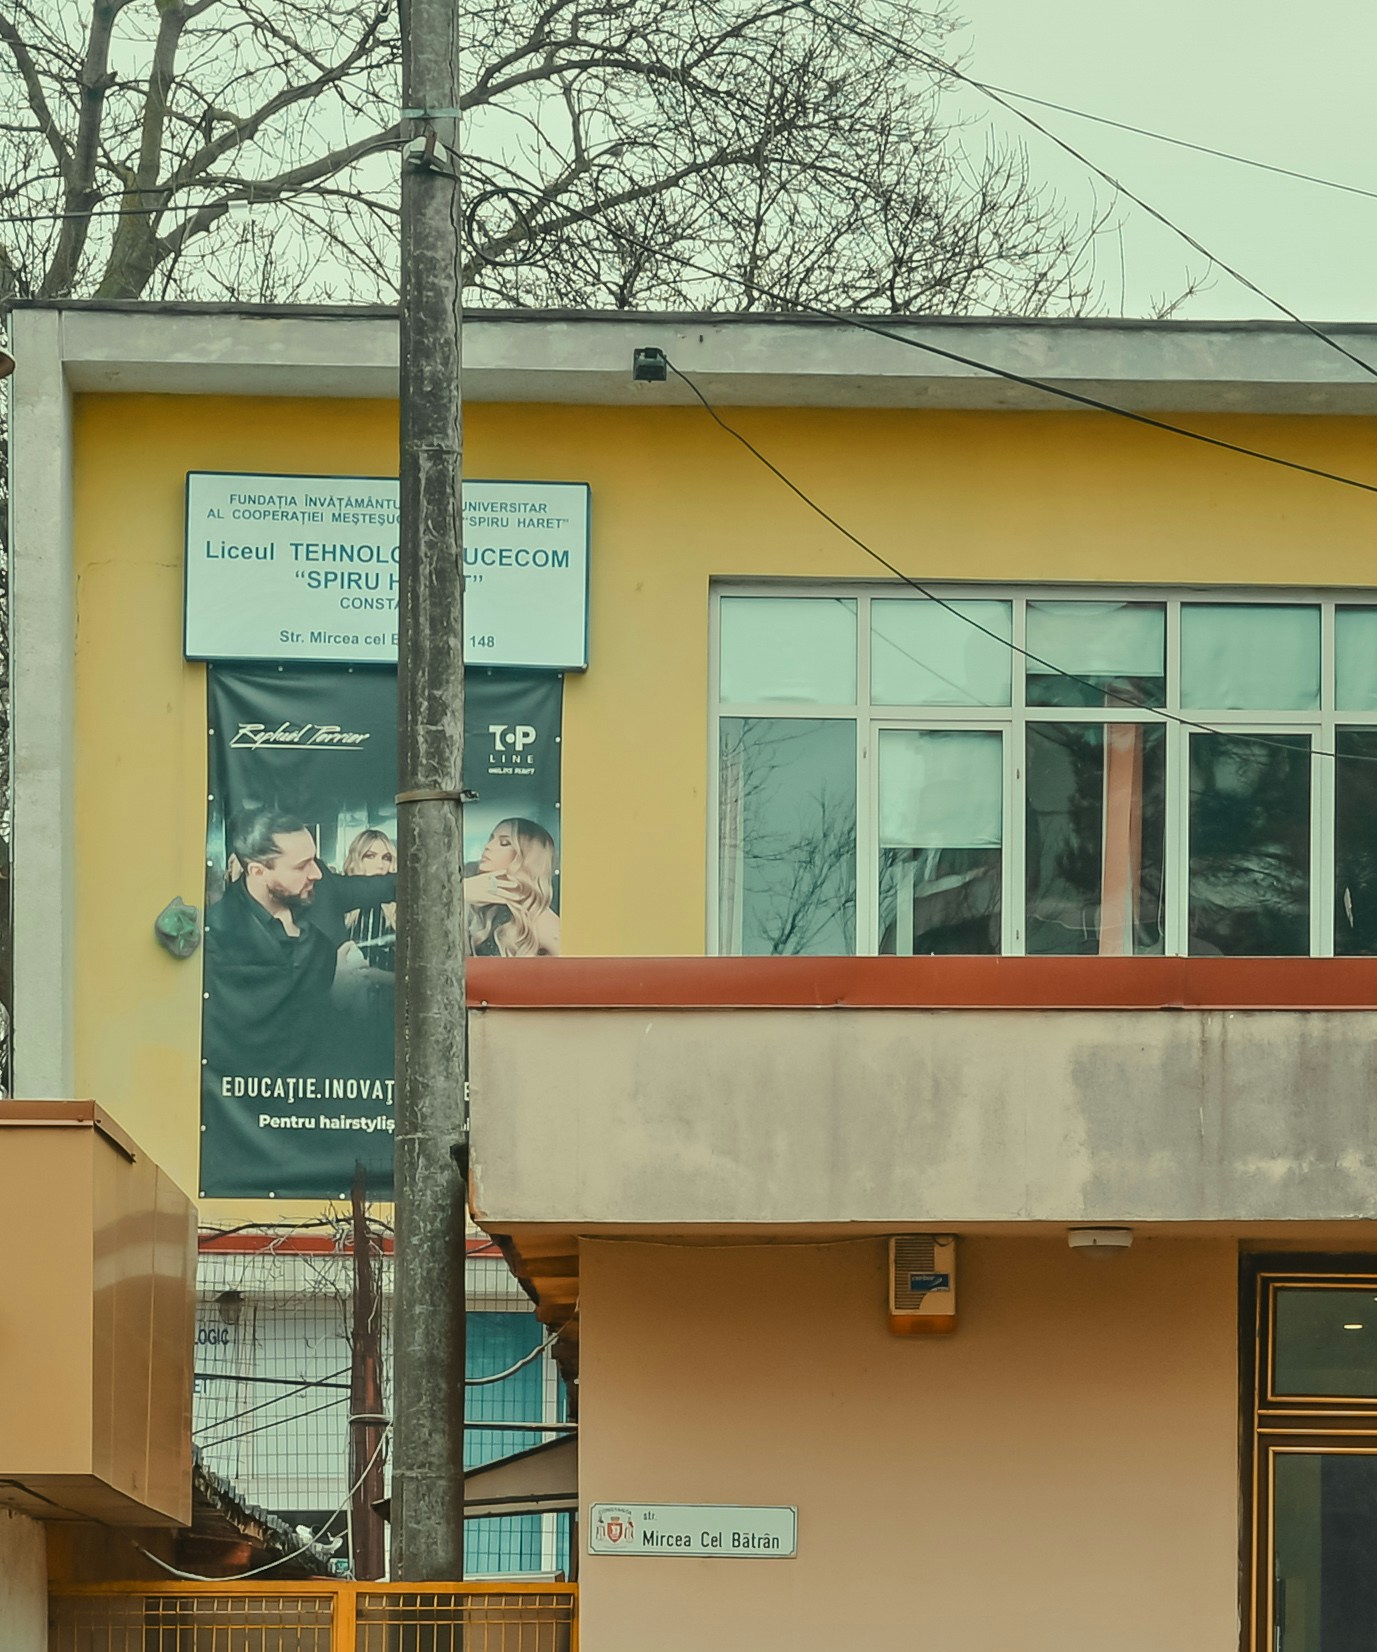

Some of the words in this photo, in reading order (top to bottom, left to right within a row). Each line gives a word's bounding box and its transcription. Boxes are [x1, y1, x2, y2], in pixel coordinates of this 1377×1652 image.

[206, 508, 225, 519] AL
[462, 501, 547, 513] UNIVERSITAR
[206, 541, 275, 561] Liceul
[279, 630, 305, 643] Str.
[309, 631, 359, 645] Mircea
[364, 633, 386, 645] cel
[469, 635, 495, 648] 148
[489, 754, 534, 764] LINE
[259, 1114, 315, 1130] Pentru
[642, 1530, 692, 1547] Mircea
[700, 1531, 723, 1548] Cel
